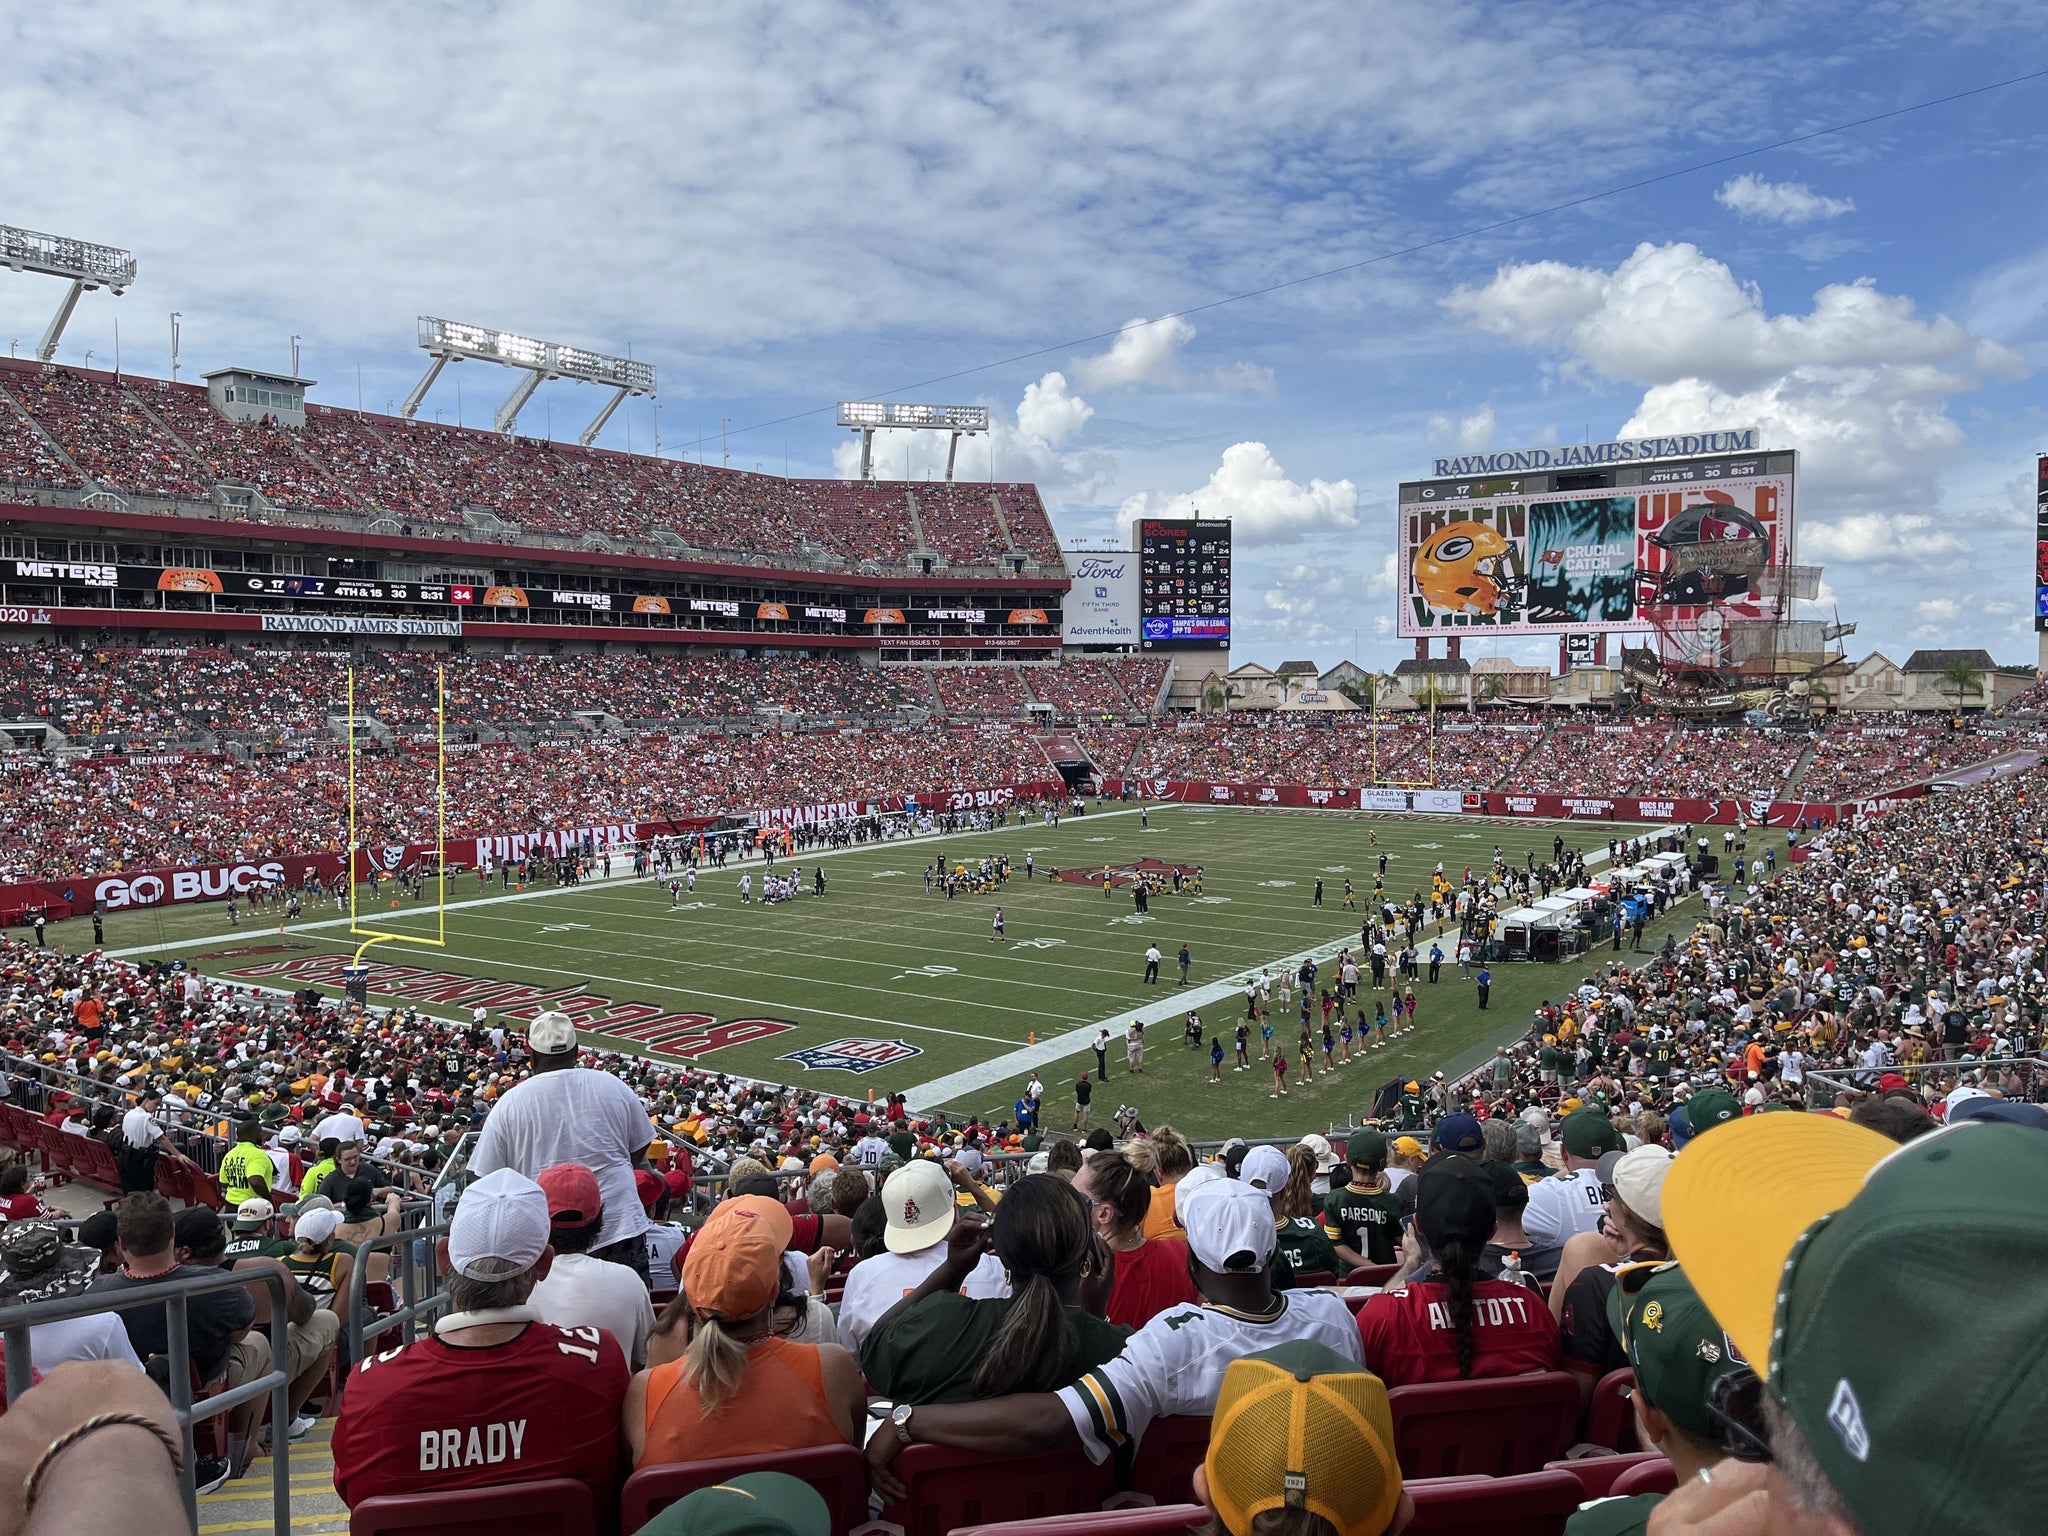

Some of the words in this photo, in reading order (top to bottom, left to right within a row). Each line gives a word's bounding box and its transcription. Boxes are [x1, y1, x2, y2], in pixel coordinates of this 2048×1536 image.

[1434, 448, 1550, 477] RAYMOND
[1553, 441, 1633, 467] JAMES
[1638, 429, 1754, 459] STADIUM
[1649, 473, 1671, 483] 4TH
[1672, 472, 1681, 481] &
[1682, 471, 1694, 480] 15
[1705, 469, 1721, 478] 30
[1730, 466, 1754, 476] 8:31
[1456, 485, 1470, 494] 17
[1510, 481, 1519, 490] 7
[1144, 521, 1164, 529] NFL
[1144, 529, 1187, 537] SCORES
[1566, 543, 1625, 558] CRUCIAL
[1077, 558, 1126, 579] Ford
[1565, 557, 1610, 571] CATCH
[16, 562, 118, 580] METERS
[85, 579, 118, 587] MUSIC
[271, 579, 285, 589] 17
[315, 582, 324, 591] 7
[335, 587, 357, 597] 4TH
[359, 588, 368, 597] &
[370, 588, 382, 598] 15
[391, 589, 407, 599] 30
[421, 591, 443, 600] 8:31
[454, 590, 470, 600] 34
[552, 591, 611, 605] METERS
[690, 600, 739, 612] METERS
[31, 609, 51, 624] LIV
[805, 607, 846, 619] METERS
[928, 610, 985, 619] METERS
[264, 616, 348, 631] RAYMOND
[349, 619, 398, 634] JAMES
[401, 621, 461, 635] STADIUM
[1070, 626, 1132, 636] AdventHealth
[1569, 638, 1588, 647] 34
[1299, 693, 1327, 703] Corona
[287, 751, 305, 759] EST
[951, 792, 973, 810] GO
[975, 787, 1014, 807] BUCS
[1463, 794, 1478, 805] 34
[1562, 799, 1583, 807] KREWE
[1583, 800, 1611, 809] STUDENT
[1572, 806, 1601, 815] ATHLETES
[1639, 802, 1657, 810] BUCS
[1658, 802, 1674, 811] FLAG
[1641, 808, 1672, 817] FOOTBALL
[94, 875, 165, 908] GO
[172, 862, 286, 900] BUCS
[905, 965, 958, 978] 10
[1838, 988, 1853, 1000] 92
[828, 1040, 913, 1062] NFL
[1657, 1050, 1669, 1061] 10
[446, 1060, 459, 1073] 80
[864, 1151, 877, 1164] 10
[1341, 1207, 1387, 1225] PARSONS
[224, 1239, 260, 1254] NELSON
[1357, 1226, 1369, 1259] 1
[1427, 1296, 1527, 1331] ALTOTT
[556, 1325, 601, 1365] 12
[419, 1418, 528, 1472] BRADY
[1286, 1478, 1303, 1487] 1921
